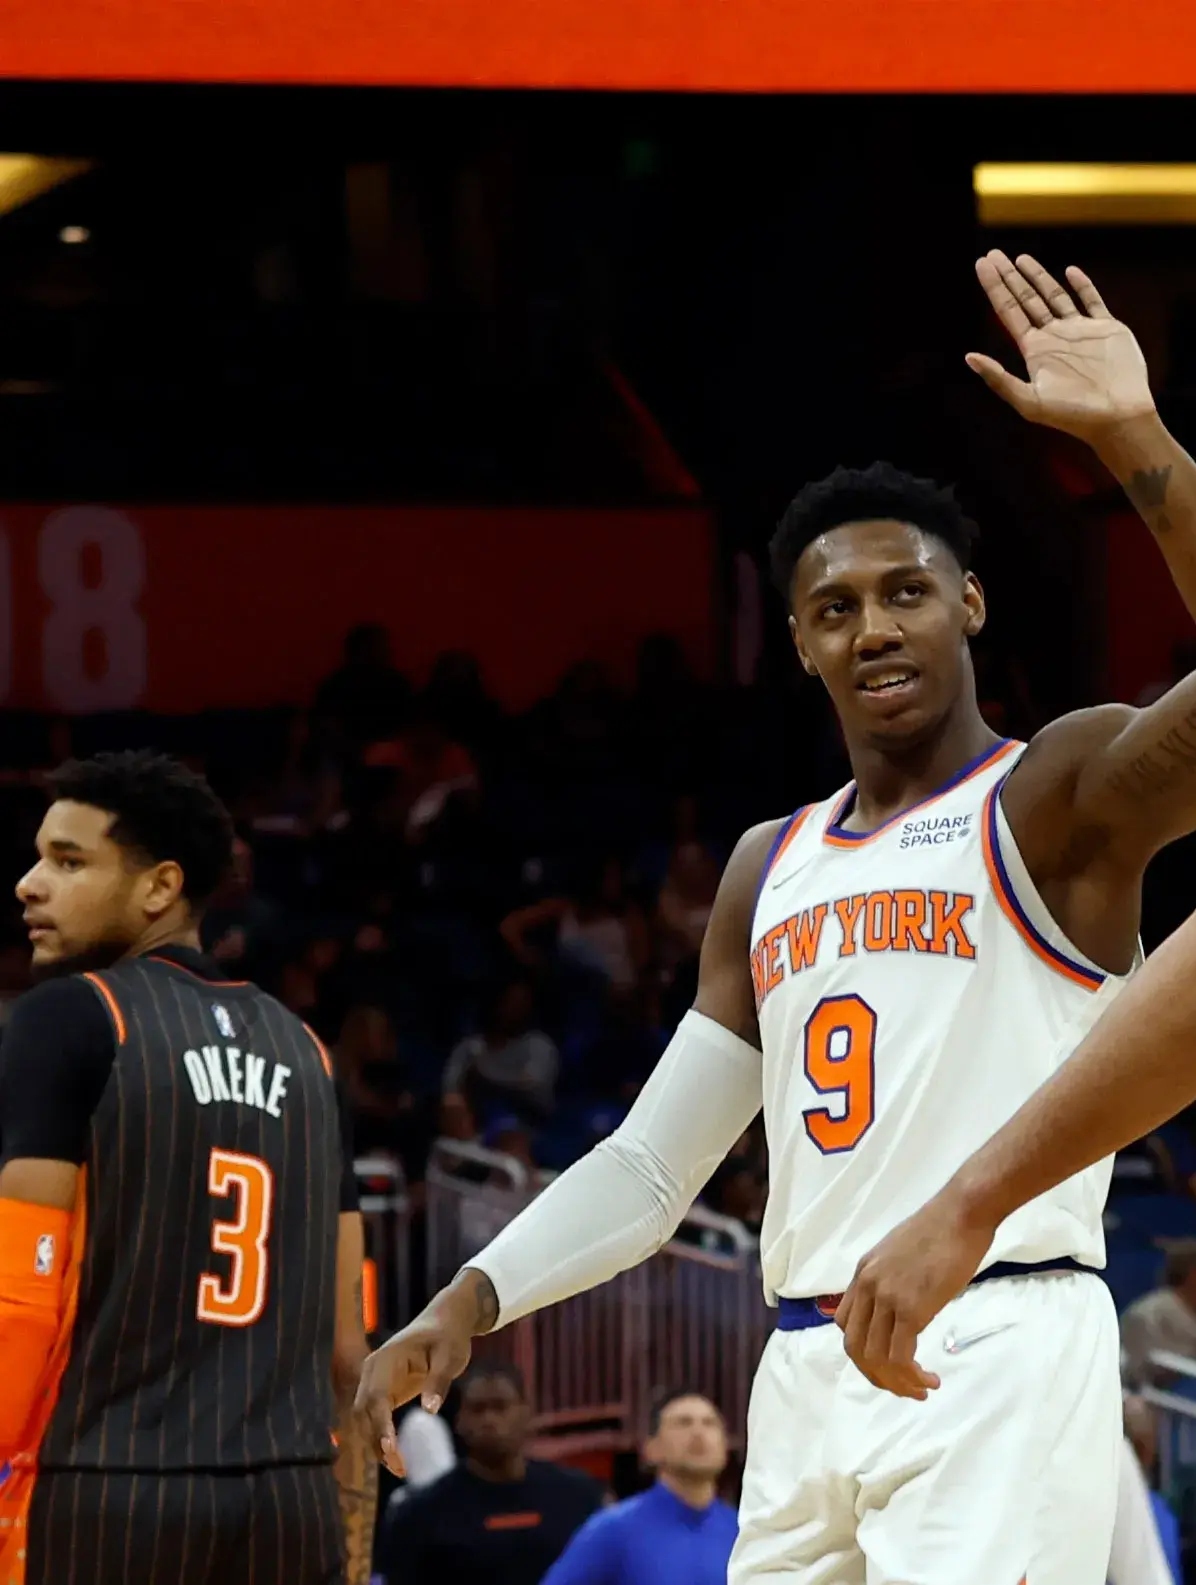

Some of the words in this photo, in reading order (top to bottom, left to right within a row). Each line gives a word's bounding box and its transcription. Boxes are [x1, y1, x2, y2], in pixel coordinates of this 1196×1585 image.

[0, 504, 149, 713] 8
[899, 830, 957, 850] SPACE
[902, 813, 973, 835] SQUARE
[751, 902, 829, 1010] NEW
[833, 888, 978, 962] YORK
[183, 1044, 291, 1118] OKEKE
[801, 992, 878, 1156] 9
[197, 1147, 274, 1328] 3
